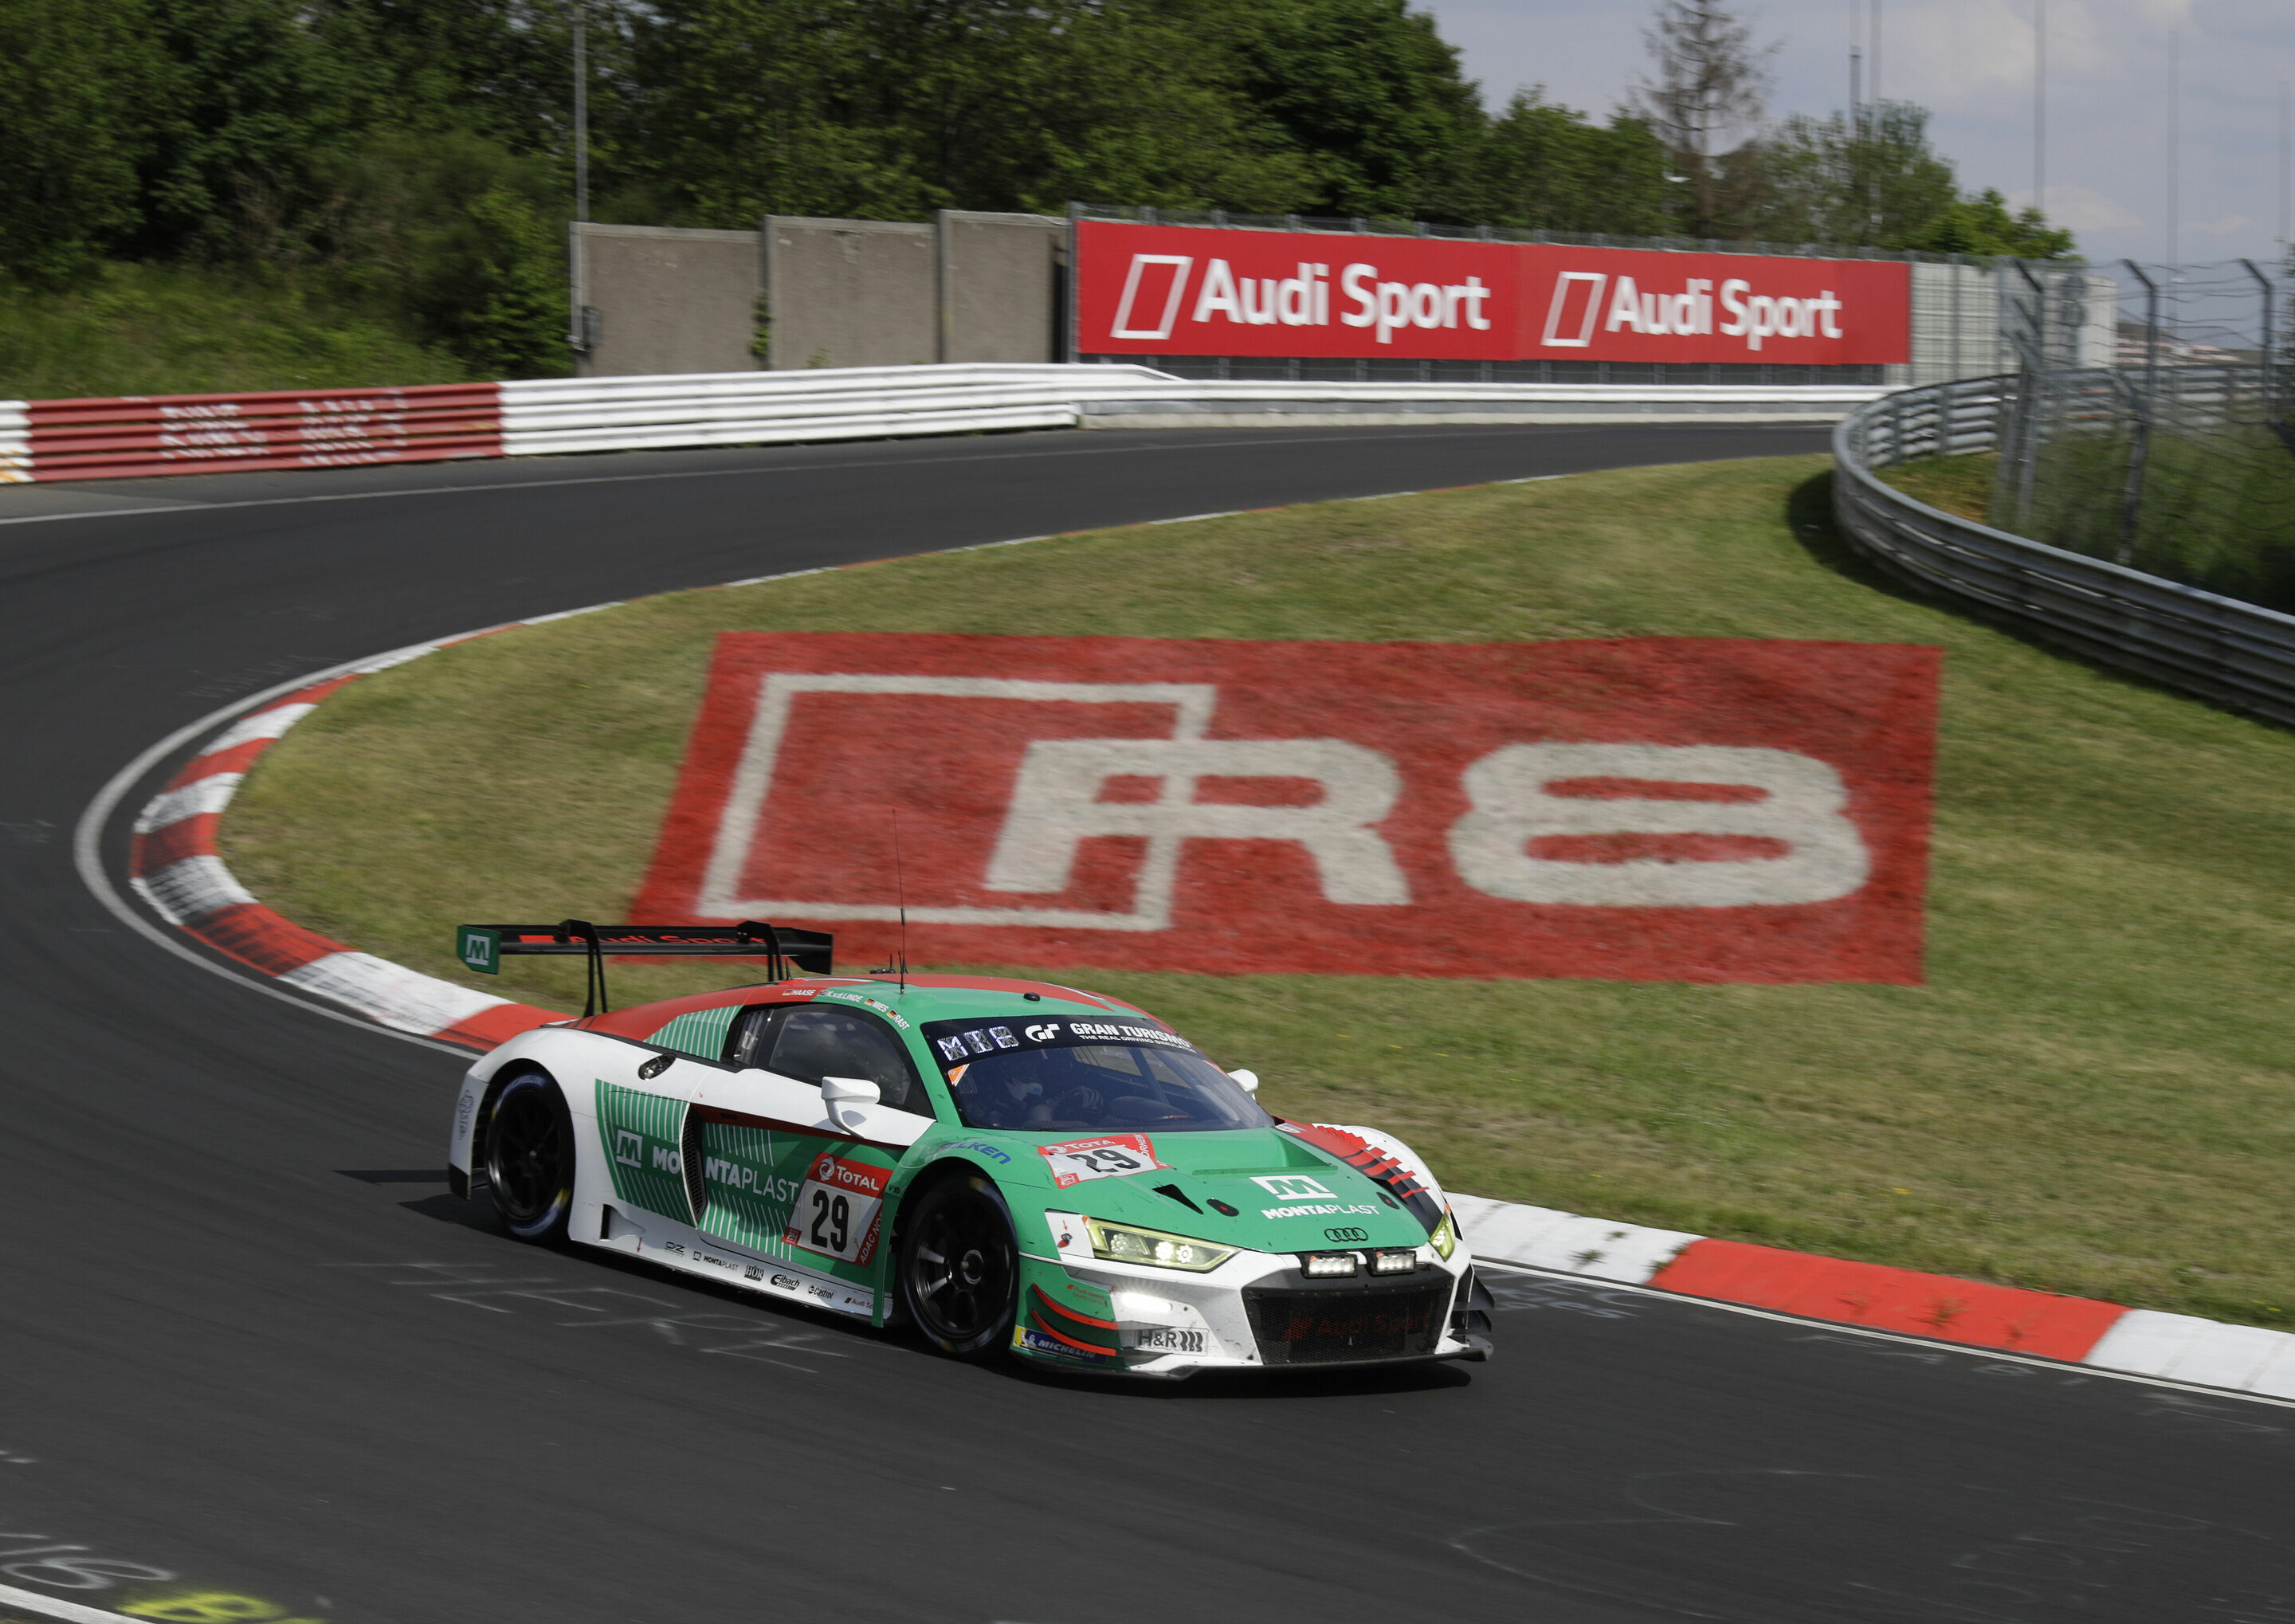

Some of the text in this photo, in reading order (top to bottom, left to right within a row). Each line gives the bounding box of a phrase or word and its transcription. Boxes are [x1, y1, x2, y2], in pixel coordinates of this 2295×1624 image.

[1192, 257, 1492, 344] Audi Sport
[1605, 275, 1842, 351] Audi Sport
[985, 736, 1869, 909] R8
[892, 1014, 910, 1030] RAST
[1069, 1022, 1192, 1049] GRAN TURISMO
[1066, 1148, 1141, 1173] 29
[837, 1166, 880, 1191] TOTAL
[811, 1189, 849, 1253] 29
[1261, 1204, 1380, 1220] MONTAPLAST
[860, 1232, 876, 1264] ADAC
[704, 1255, 739, 1271] MONTAPLAST
[771, 1274, 800, 1288] Eibach
[814, 1288, 834, 1300] Castrol
[1038, 1339, 1096, 1359] MICHELIN
[1139, 1331, 1178, 1349] H&R
